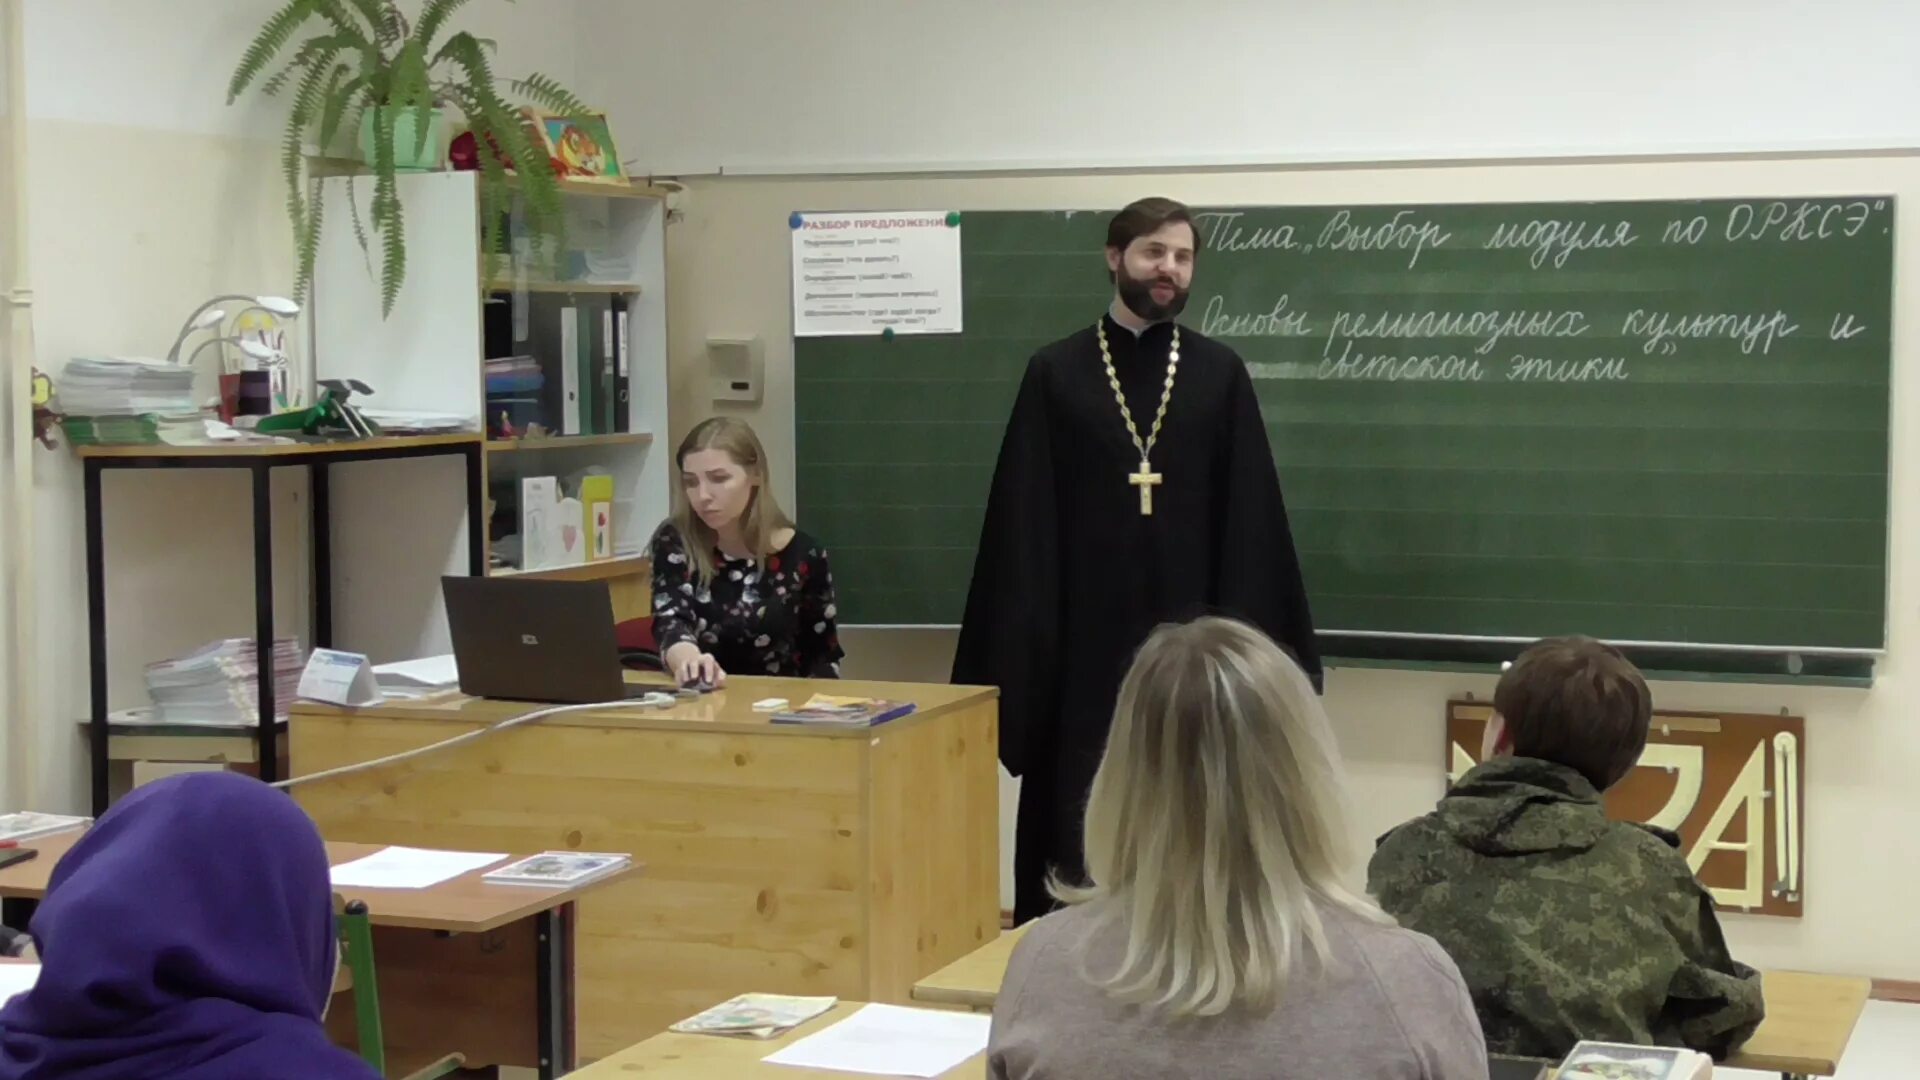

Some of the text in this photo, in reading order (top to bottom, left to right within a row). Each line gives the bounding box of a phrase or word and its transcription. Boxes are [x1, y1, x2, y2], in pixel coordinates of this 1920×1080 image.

[803, 220, 850, 230] РАЗБОР
[1484, 219, 1640, 270] модуля
[1662, 215, 1709, 245] по
[1200, 294, 1866, 356] Основы религиозных культур и
[1318, 340, 1484, 381] светской
